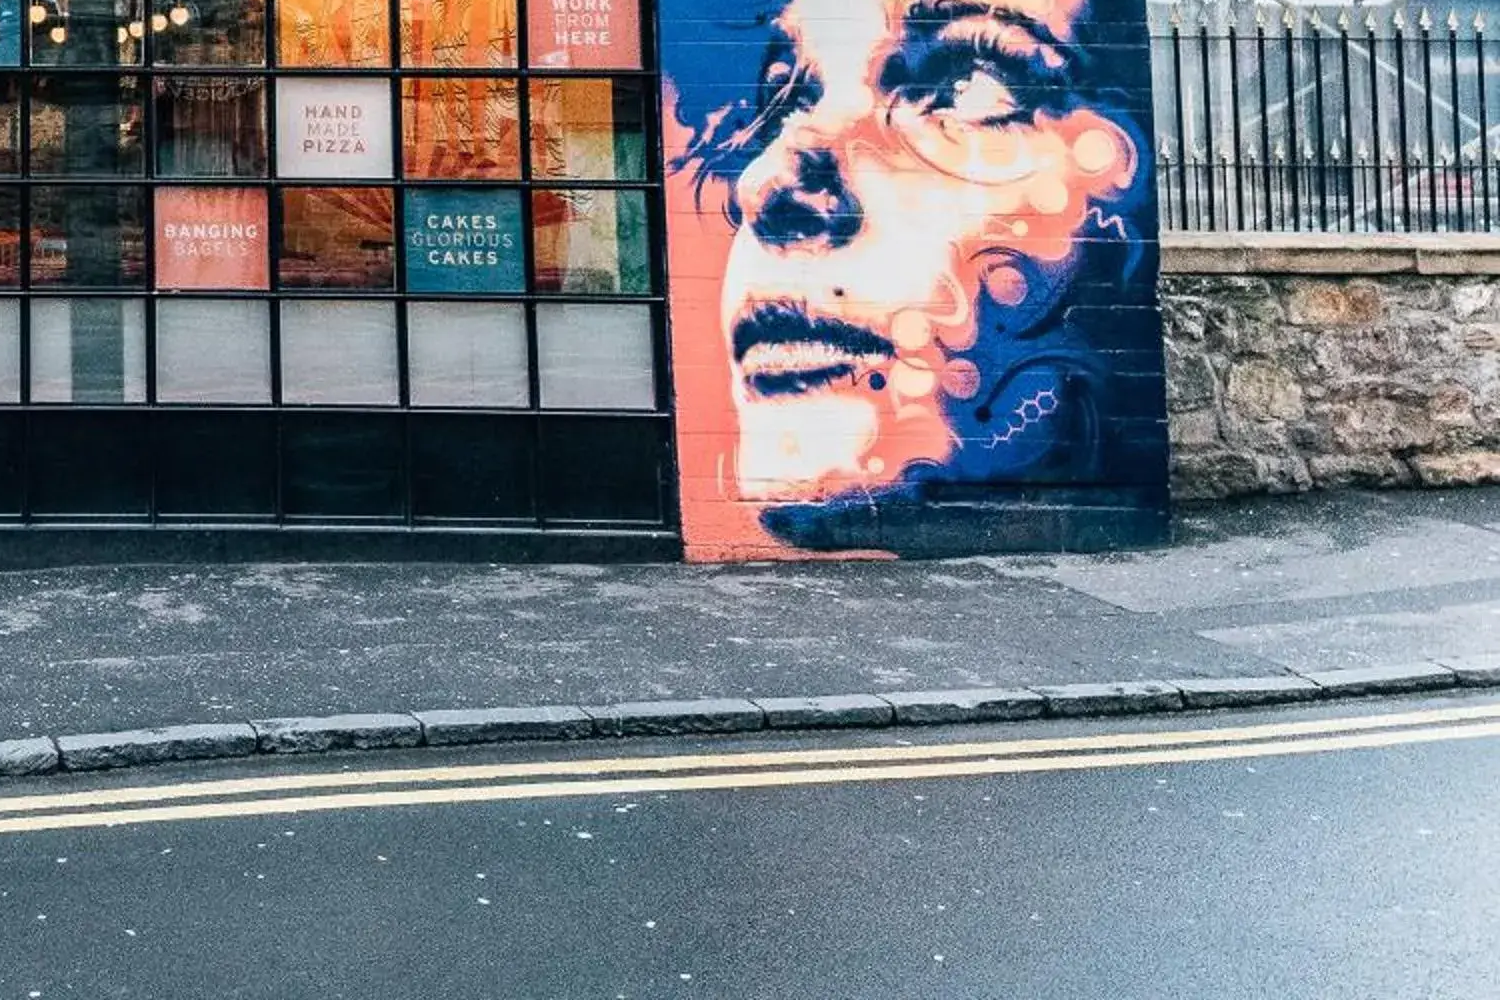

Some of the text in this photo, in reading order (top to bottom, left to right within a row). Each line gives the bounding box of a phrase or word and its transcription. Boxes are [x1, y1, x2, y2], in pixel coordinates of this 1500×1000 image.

[555, 12, 609, 28] FROM
[555, 30, 612, 45] HERE
[305, 105, 362, 119] HAND
[307, 121, 360, 137] MADE
[303, 138, 366, 153] PIZZA
[427, 214, 497, 229] CAKES
[163, 223, 258, 239] BANGING
[411, 231, 513, 248] GLORIOUS
[428, 250, 498, 265] CAKES
